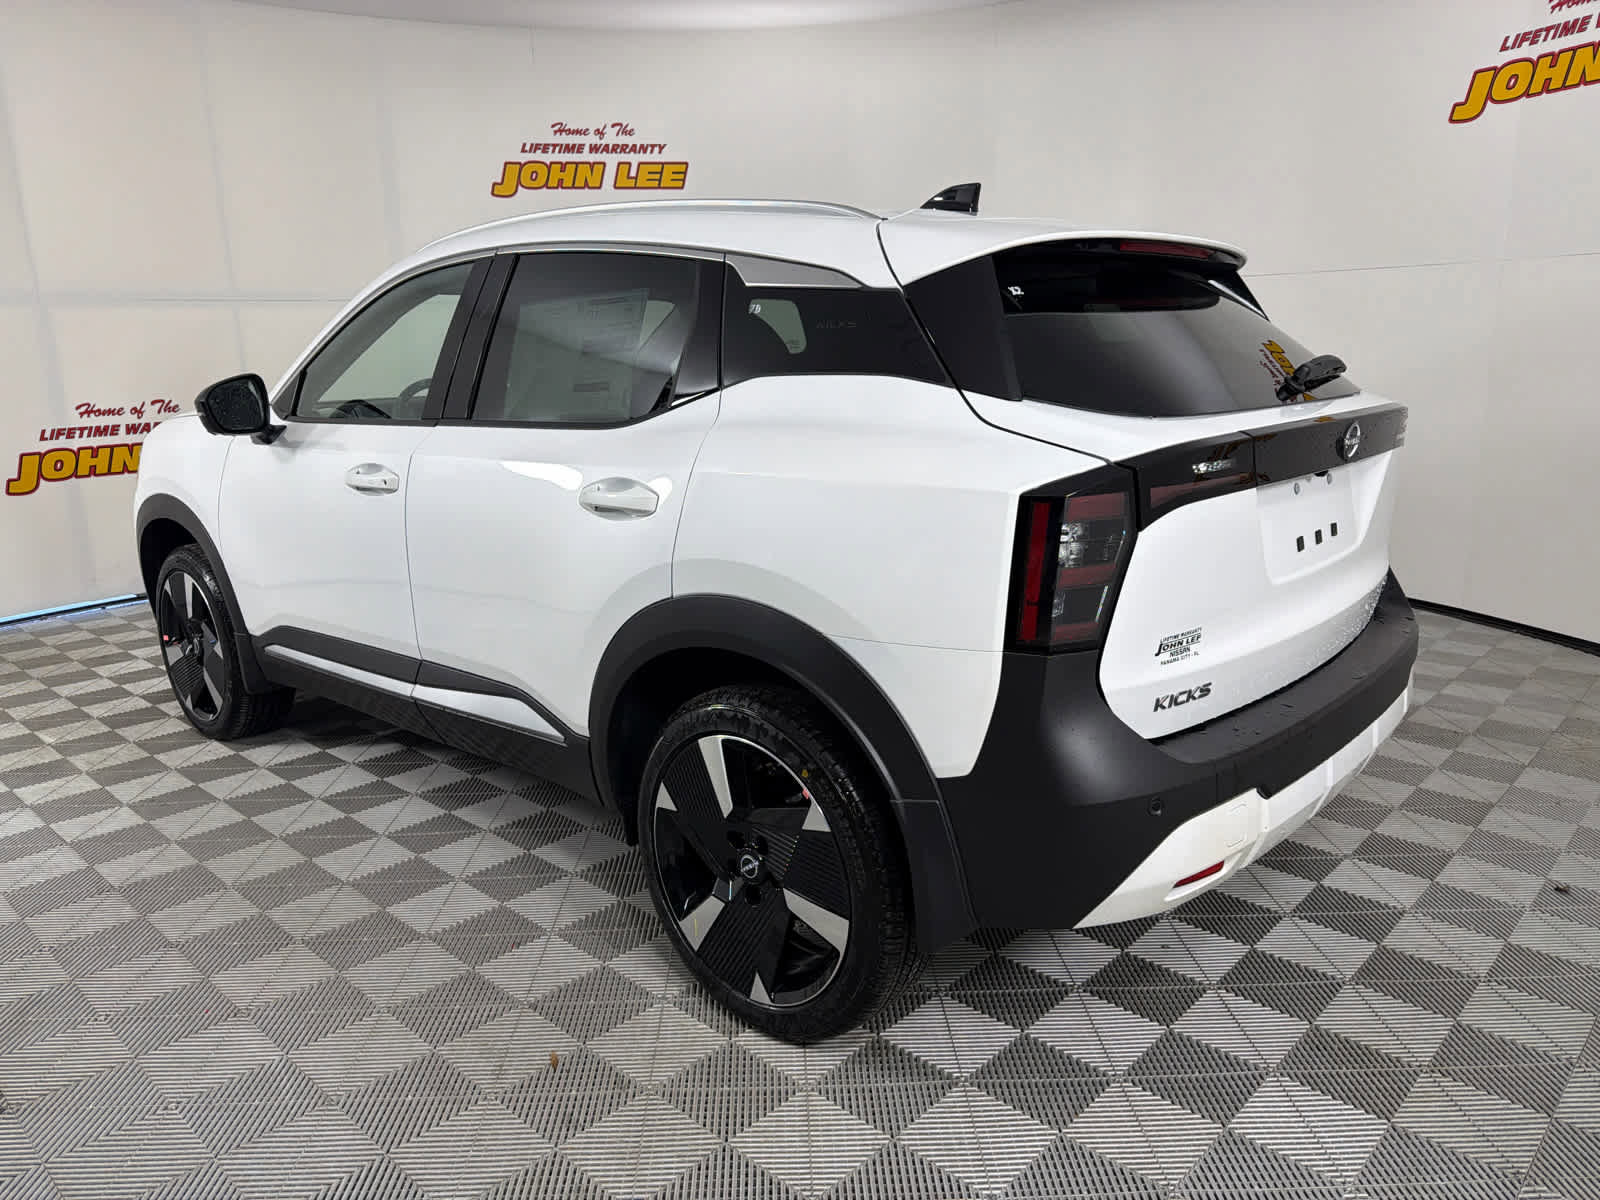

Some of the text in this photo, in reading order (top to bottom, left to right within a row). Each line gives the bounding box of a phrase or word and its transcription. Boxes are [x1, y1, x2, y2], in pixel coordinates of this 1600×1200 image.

[1499, 14, 1593, 52] LIFETIME
[1448, 41, 1600, 124] JOHN
[551, 122, 635, 140] Home of The
[520, 143, 667, 154] LIFETIME WARRANTY
[491, 161, 689, 198] JOHN LEE
[75, 399, 182, 420] Home of The
[39, 423, 121, 442] LIFETIME
[5, 442, 143, 496] JOHN
[1154, 639, 1184, 656] JOHN
[1169, 646, 1191, 657] NISSAN
[1153, 682, 1213, 712] KICKS
